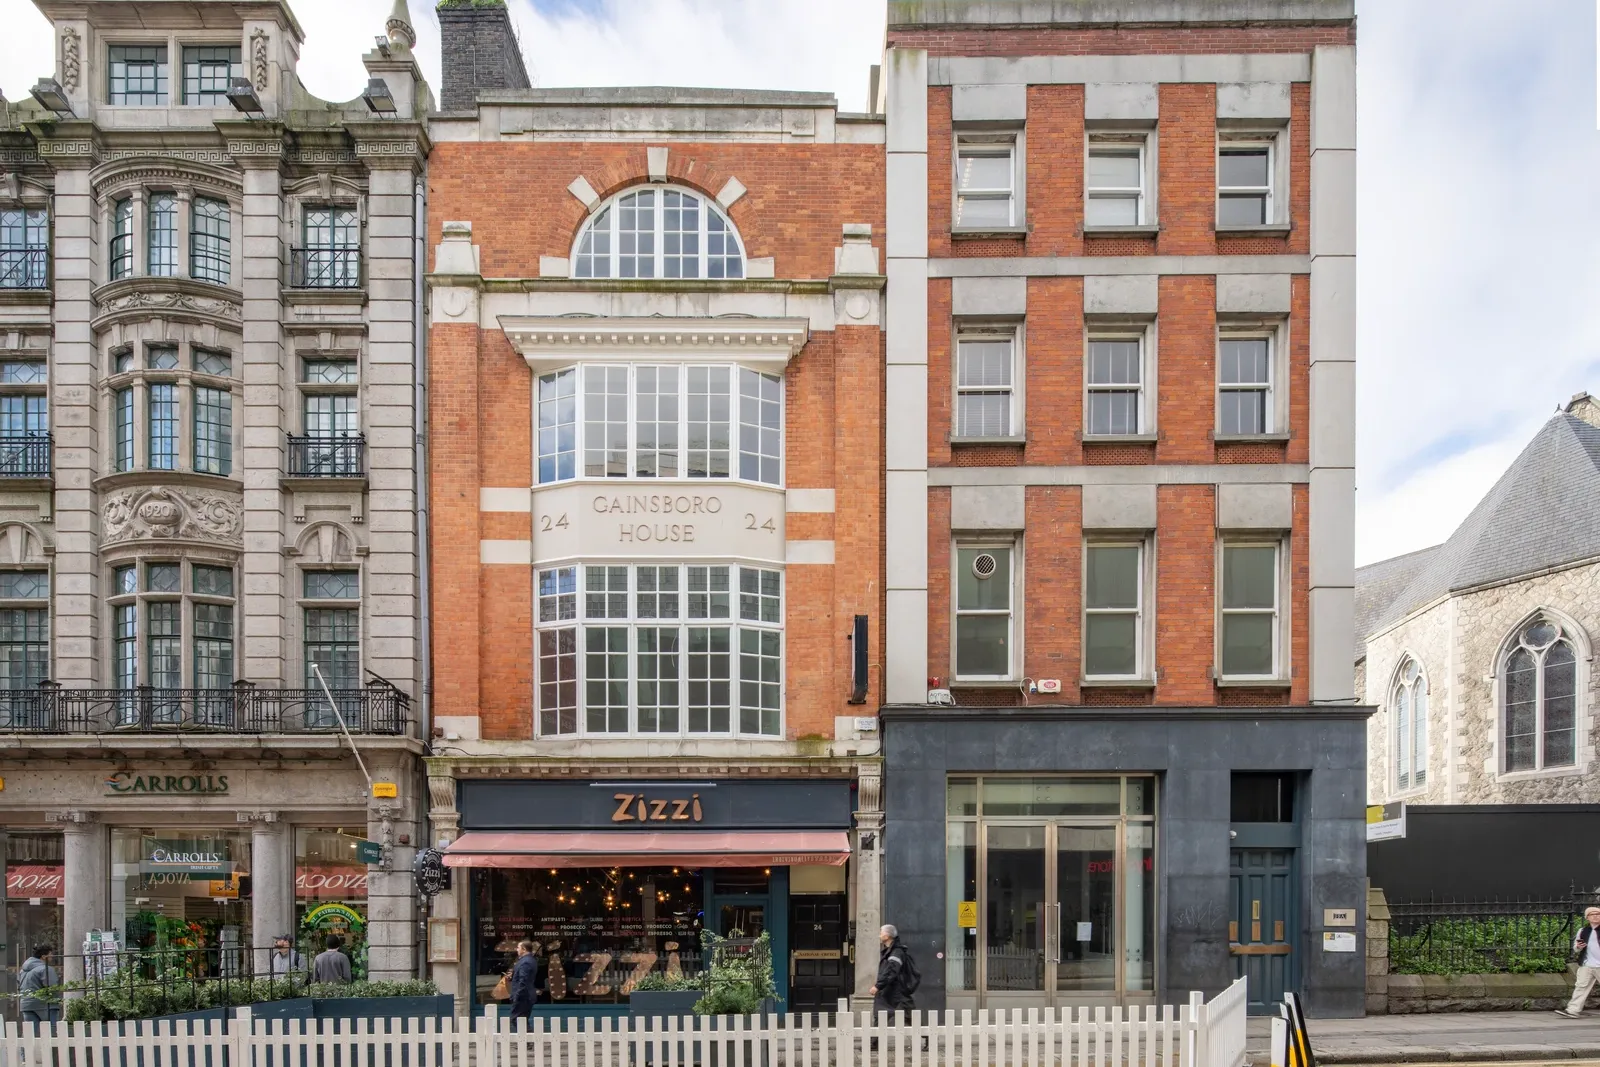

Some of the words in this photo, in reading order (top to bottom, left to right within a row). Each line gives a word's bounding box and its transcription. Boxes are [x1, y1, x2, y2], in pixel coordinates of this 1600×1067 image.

[592, 495, 722, 514] GAINSBORO
[540, 513, 570, 532] 24
[744, 512, 776, 534] 24
[619, 523, 695, 542] HOUSE
[611, 793, 703, 822] Zizzi
[153, 848, 219, 863] CARROLLS
[424, 866, 441, 878] Zizzi
